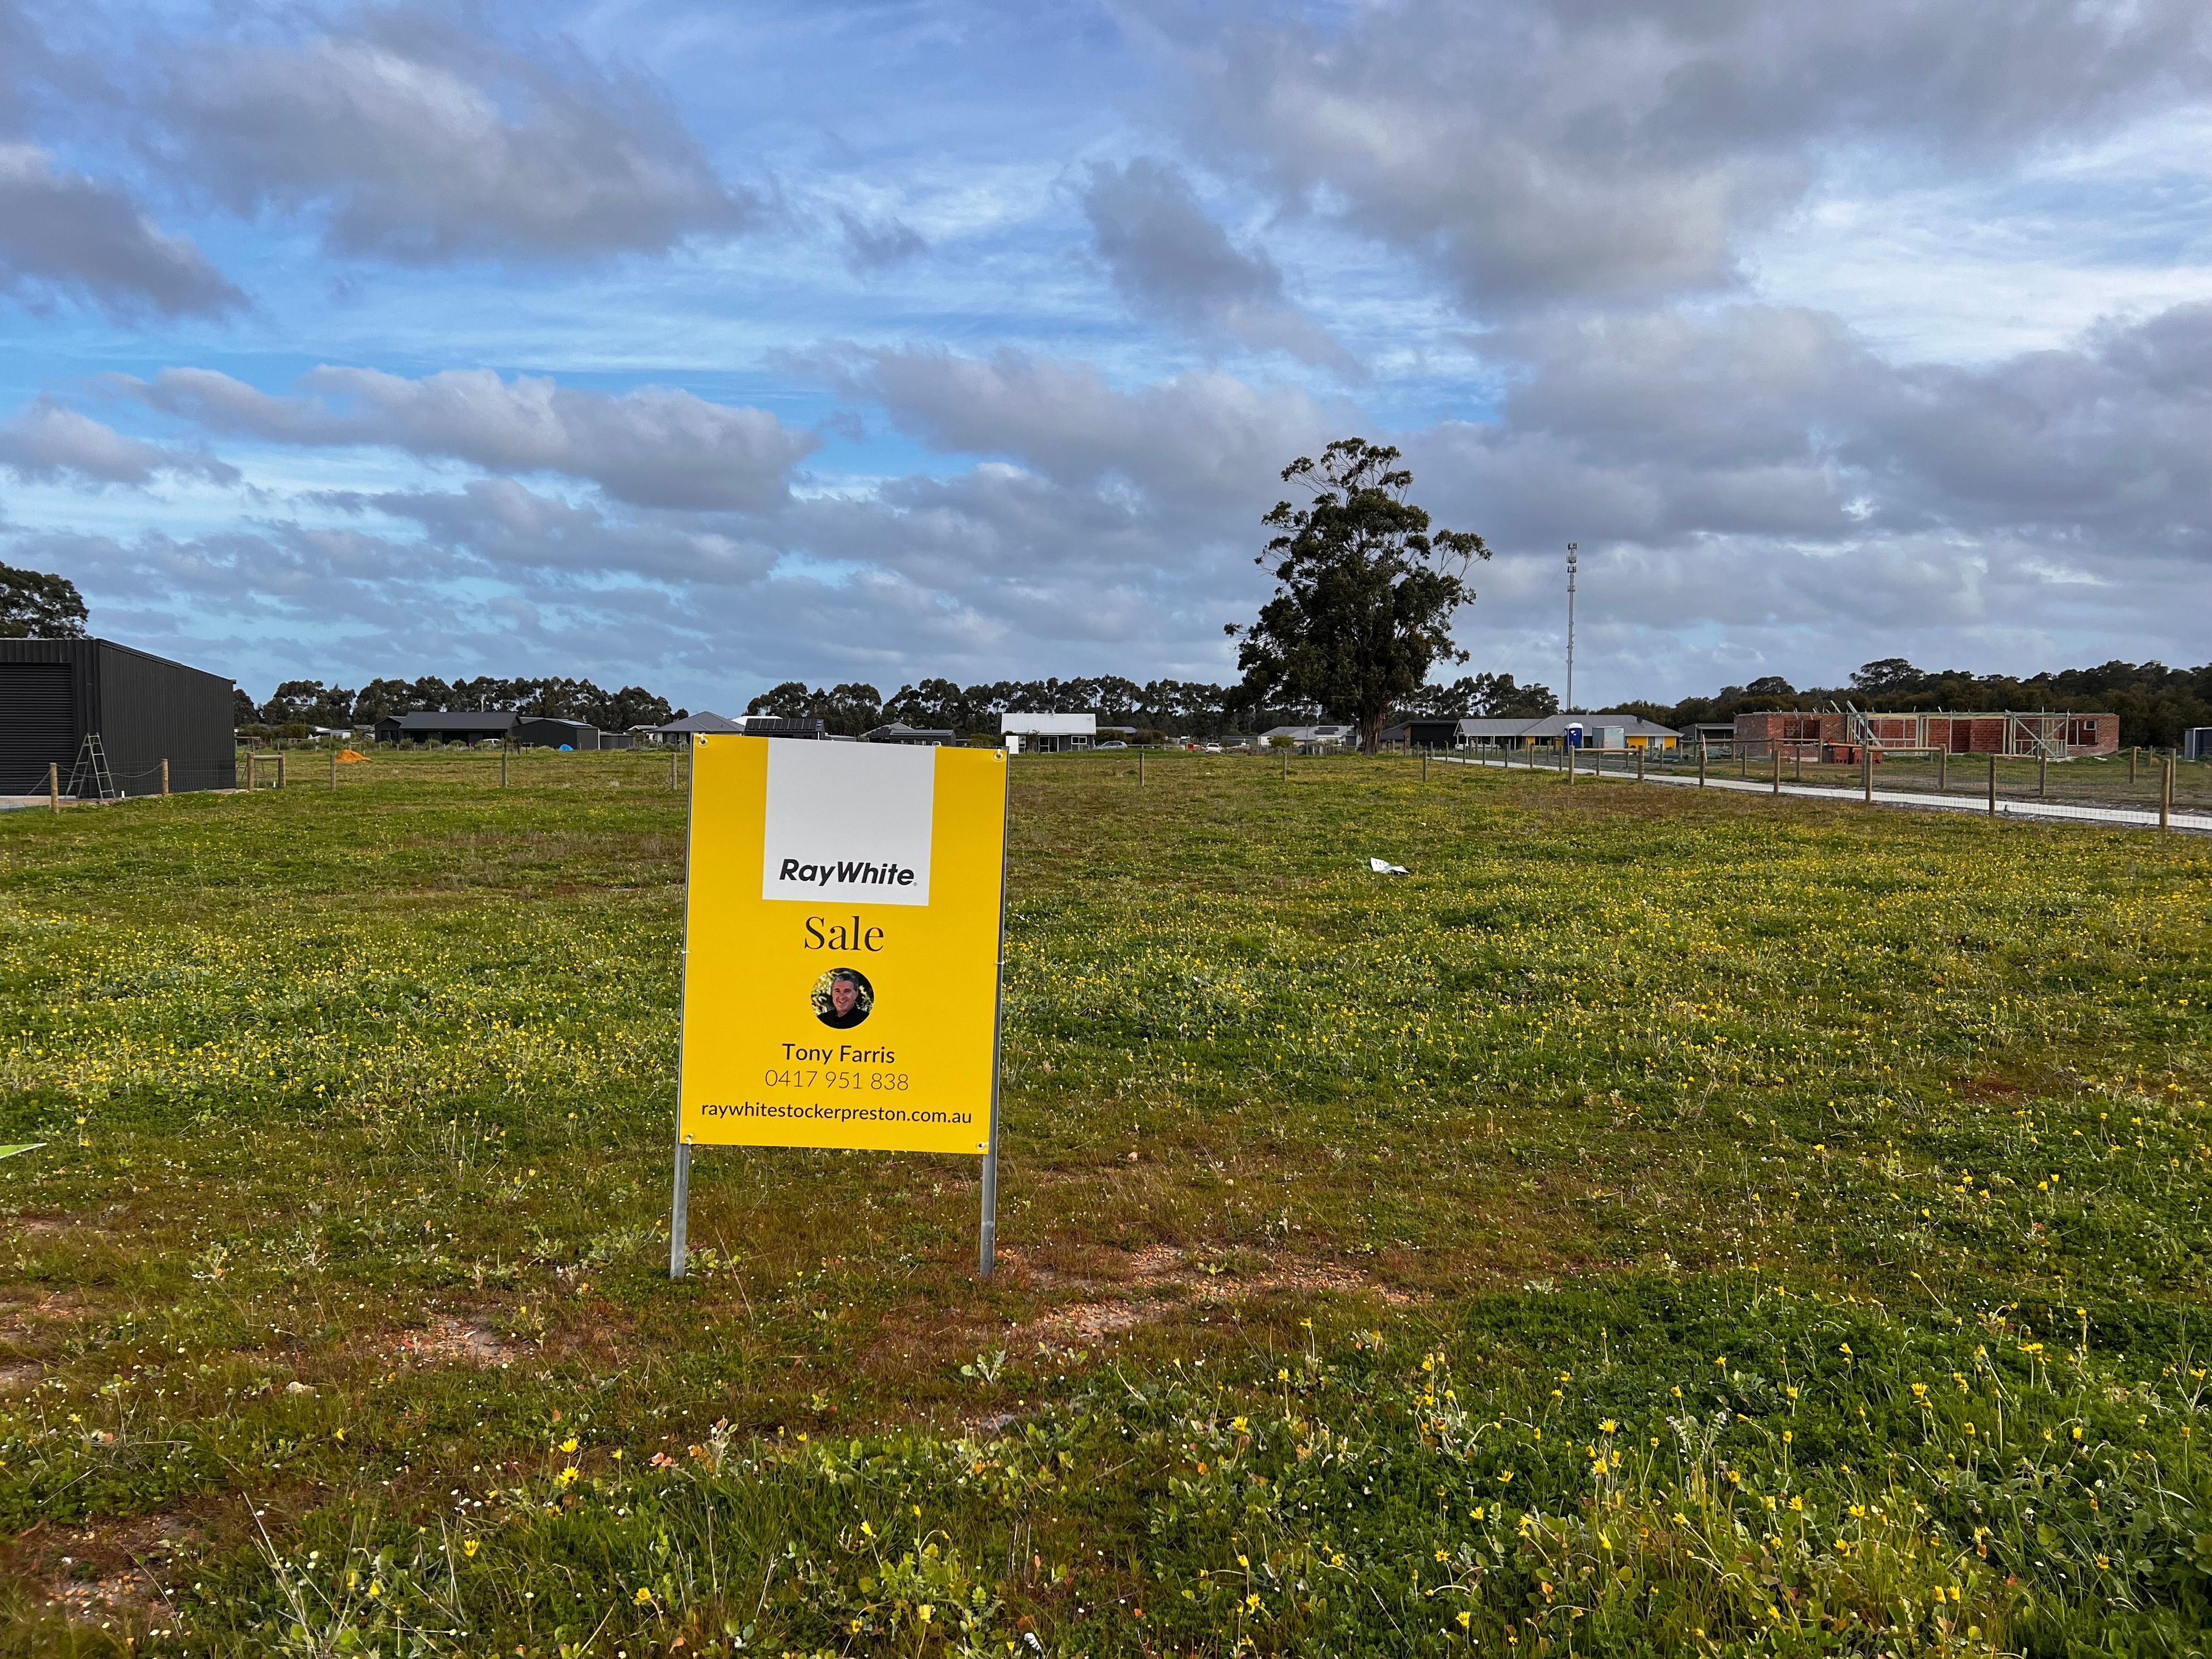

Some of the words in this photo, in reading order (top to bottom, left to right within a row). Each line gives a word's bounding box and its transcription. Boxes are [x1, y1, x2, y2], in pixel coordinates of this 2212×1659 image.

[804, 915, 884, 952] Sale
[782, 1043, 834, 1065] Tony
[840, 1045, 895, 1064] Farris
[765, 1069, 818, 1088] 0417
[825, 1071, 862, 1089] 951
[870, 1073, 908, 1091] 838
[702, 1101, 972, 1124] raywhitestockerpreston.com.au
